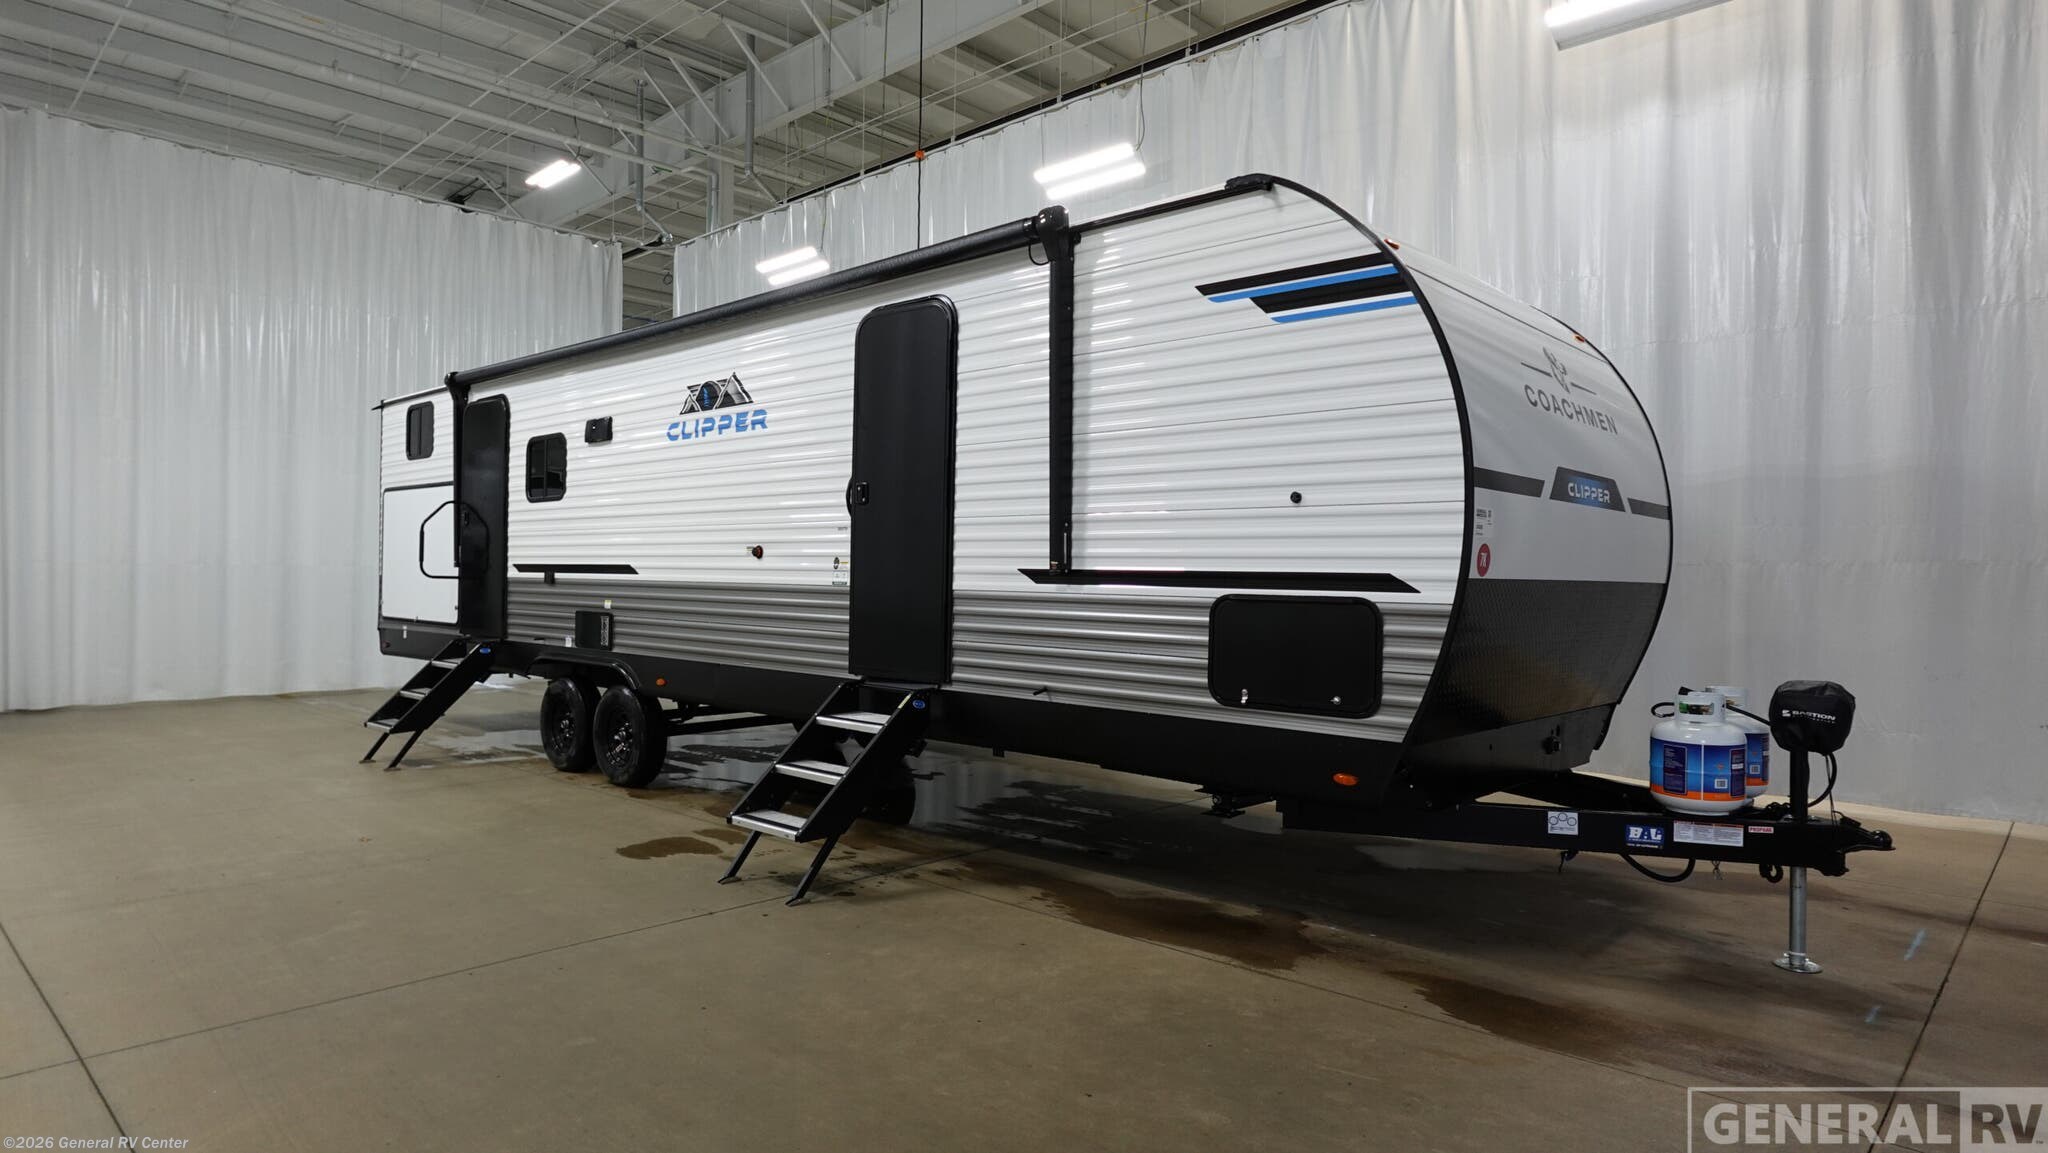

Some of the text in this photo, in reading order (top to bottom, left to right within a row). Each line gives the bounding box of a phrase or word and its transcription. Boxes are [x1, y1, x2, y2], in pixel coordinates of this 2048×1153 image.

[666, 409, 768, 441] CLIPPER
[1523, 384, 1618, 435] COACHMEN
[1567, 481, 1610, 504] CLIPPER
